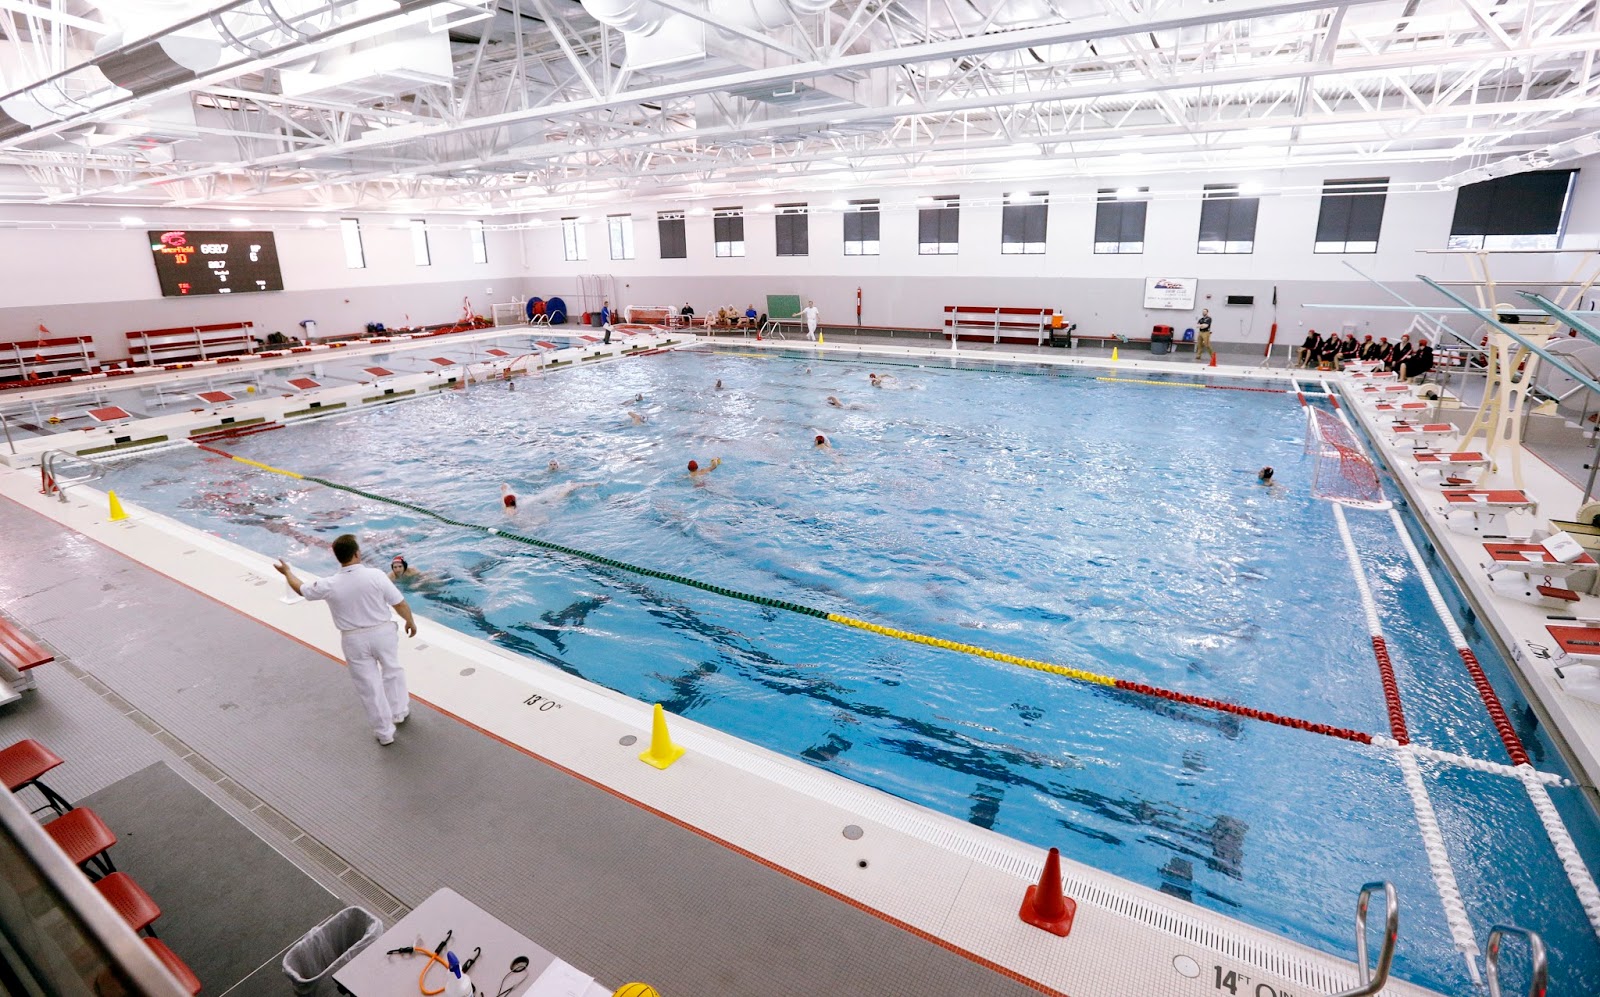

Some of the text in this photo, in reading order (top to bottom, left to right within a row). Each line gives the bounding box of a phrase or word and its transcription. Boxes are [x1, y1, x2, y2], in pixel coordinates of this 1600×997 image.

[175, 253, 187, 264] 10
[1488, 513, 1496, 524] 7
[1543, 575, 1552, 588] 8
